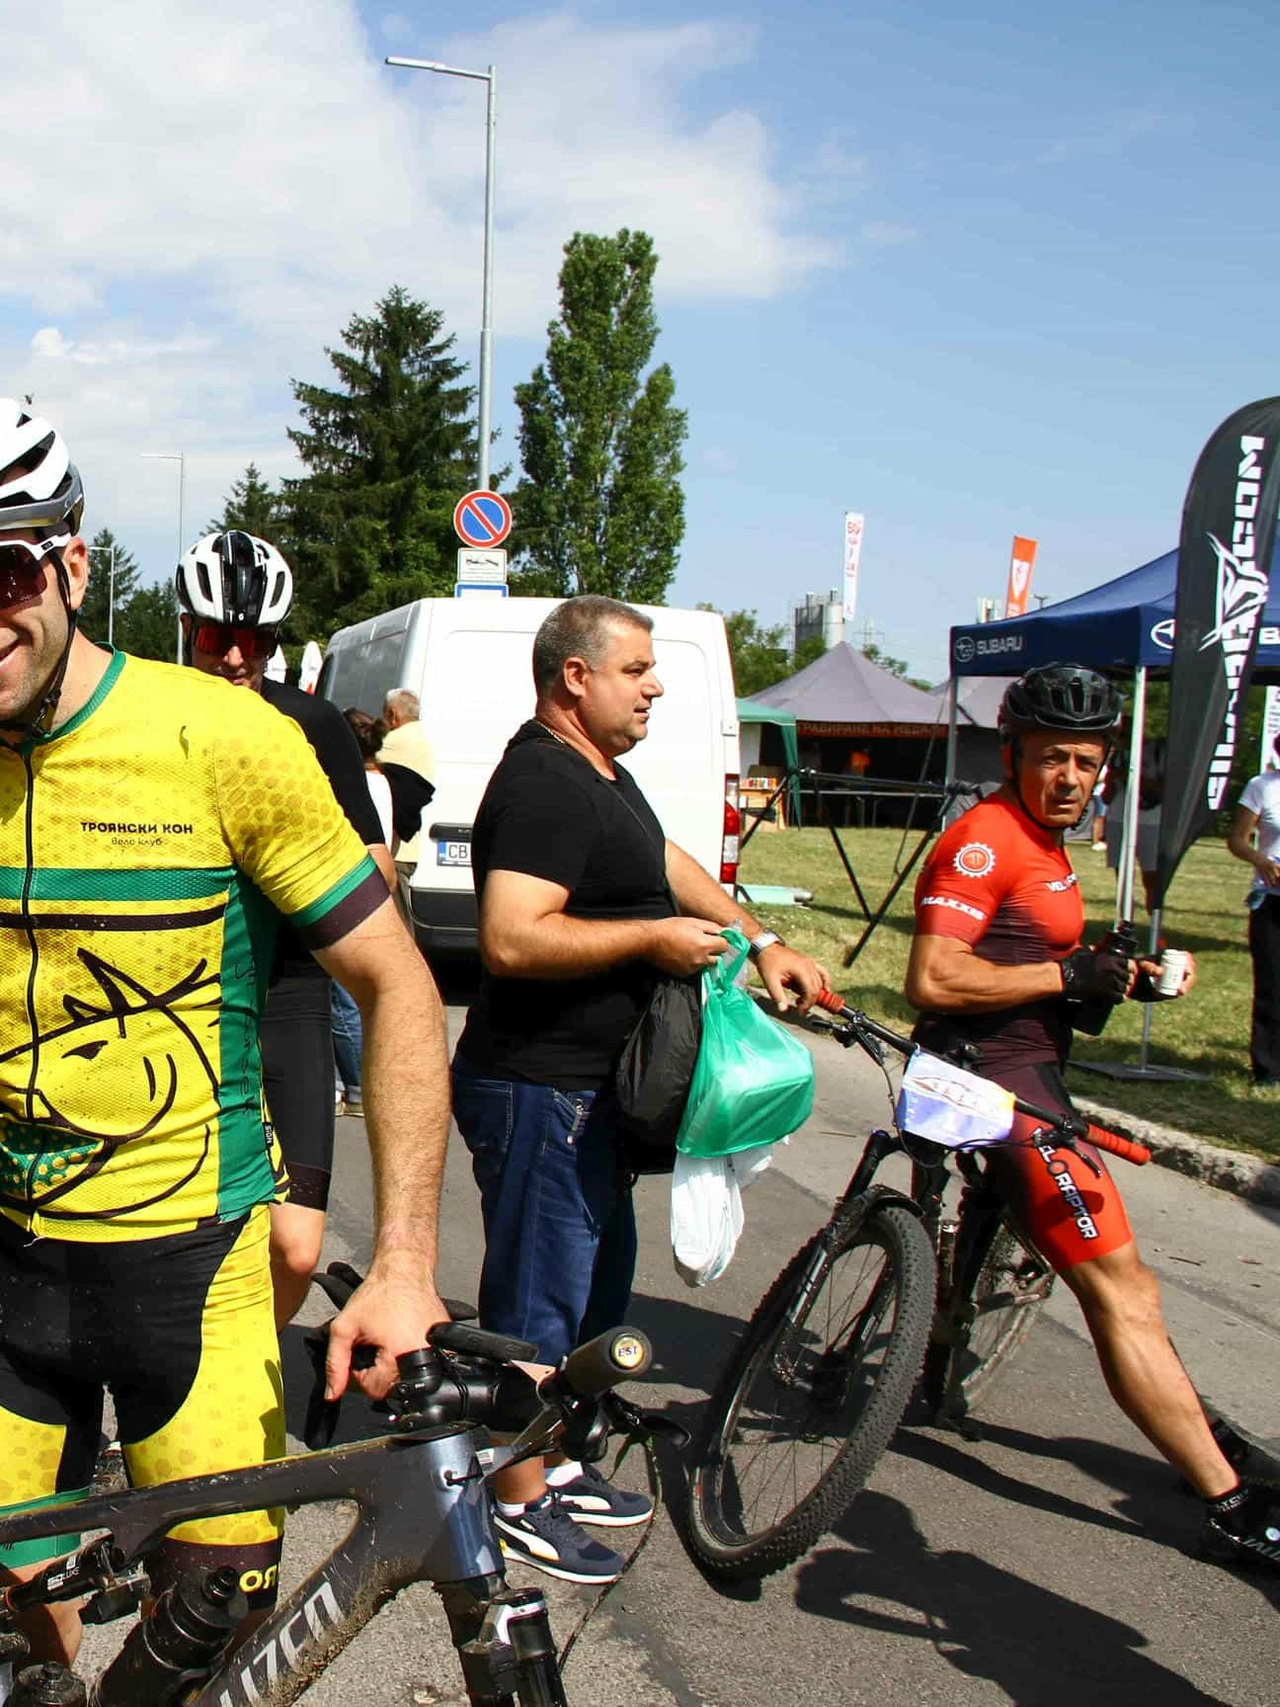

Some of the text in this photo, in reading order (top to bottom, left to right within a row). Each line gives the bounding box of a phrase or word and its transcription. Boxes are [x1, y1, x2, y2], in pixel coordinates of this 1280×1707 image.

[976, 635, 1023, 655] SUBARU
[81, 822, 193, 834] ТРОЯНСКИ КОН
[921, 896, 987, 922] MAXXIS
